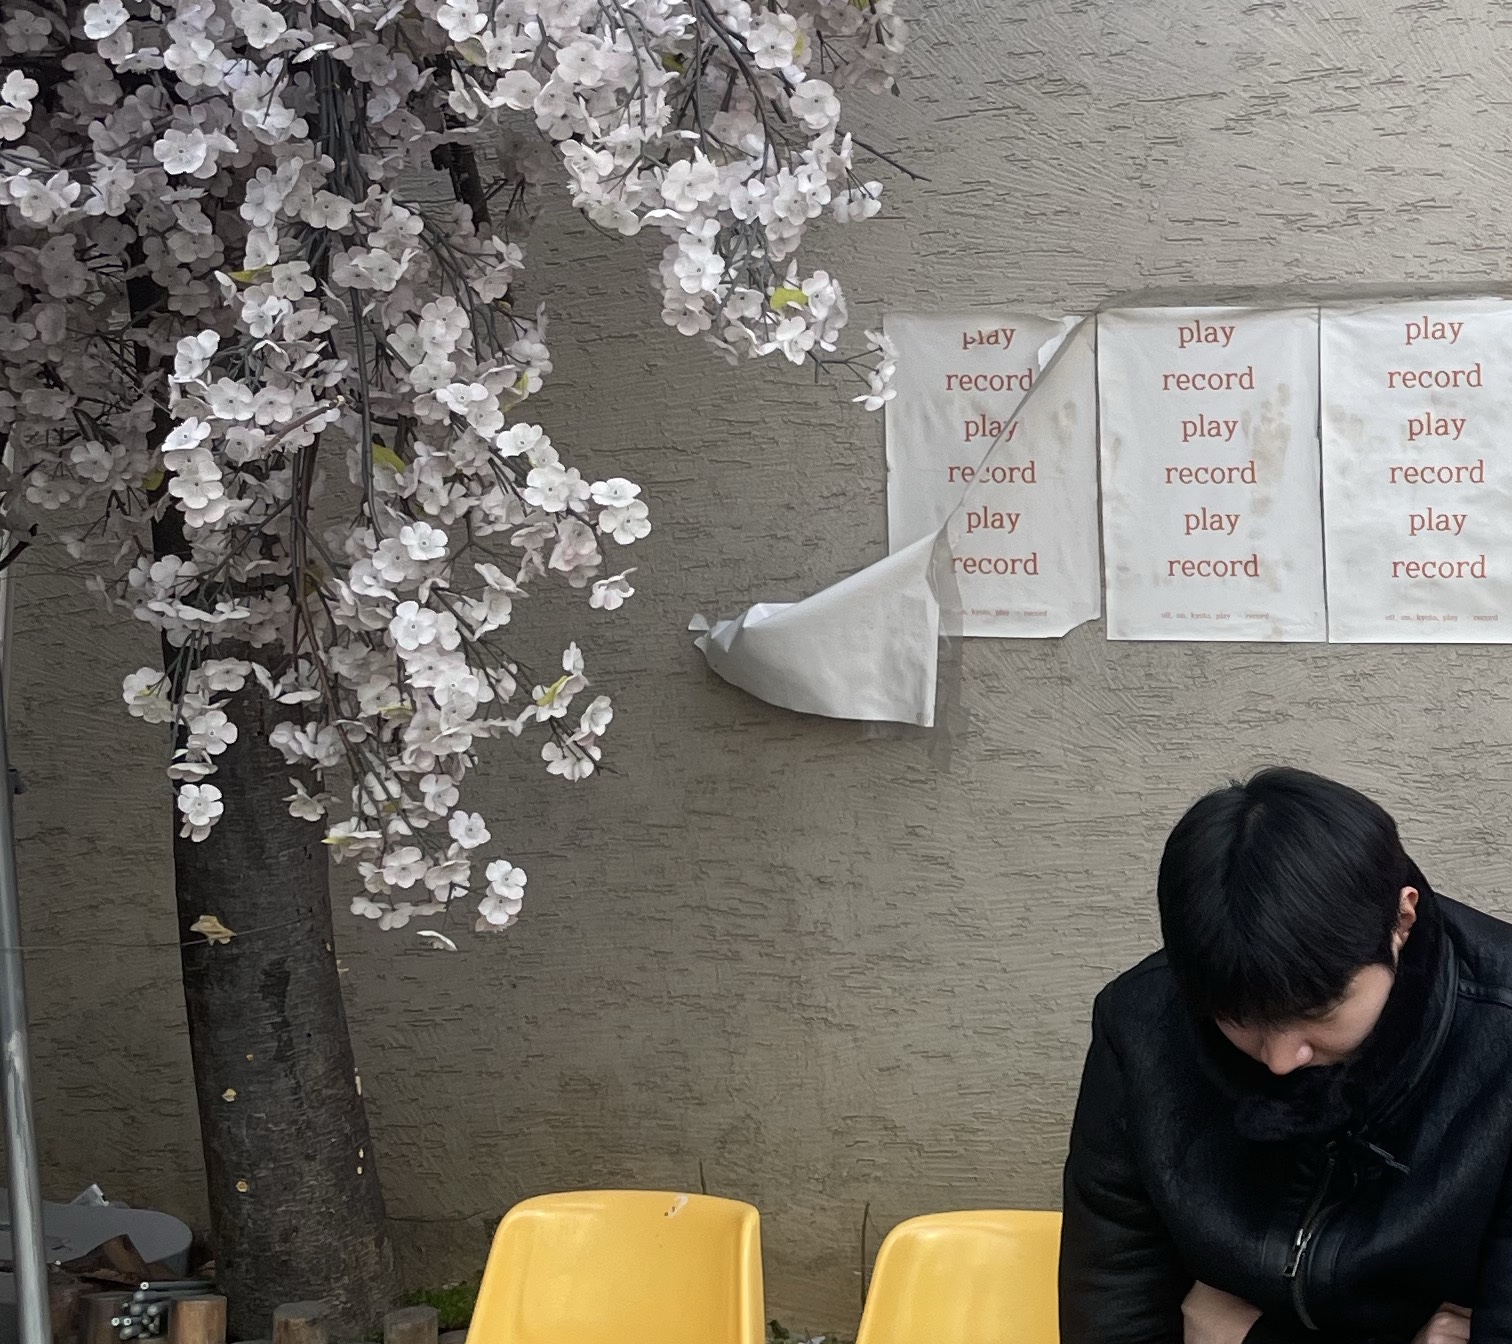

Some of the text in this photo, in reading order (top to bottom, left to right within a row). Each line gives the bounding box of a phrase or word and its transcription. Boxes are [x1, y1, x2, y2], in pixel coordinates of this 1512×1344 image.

[1178, 320, 1236, 348] play
[1405, 314, 1464, 346] play
[946, 368, 1034, 392] record
[1162, 366, 1256, 391] record
[1387, 364, 1484, 389] record
[1182, 414, 1239, 443] play
[1408, 413, 1467, 442] play
[1165, 460, 1258, 485] record
[1390, 459, 1486, 485] record
[967, 506, 1021, 533] play
[1185, 507, 1241, 536] play
[1409, 508, 1468, 537] play
[951, 553, 1039, 576] record
[1168, 554, 1260, 577] record
[1392, 555, 1489, 580] record
